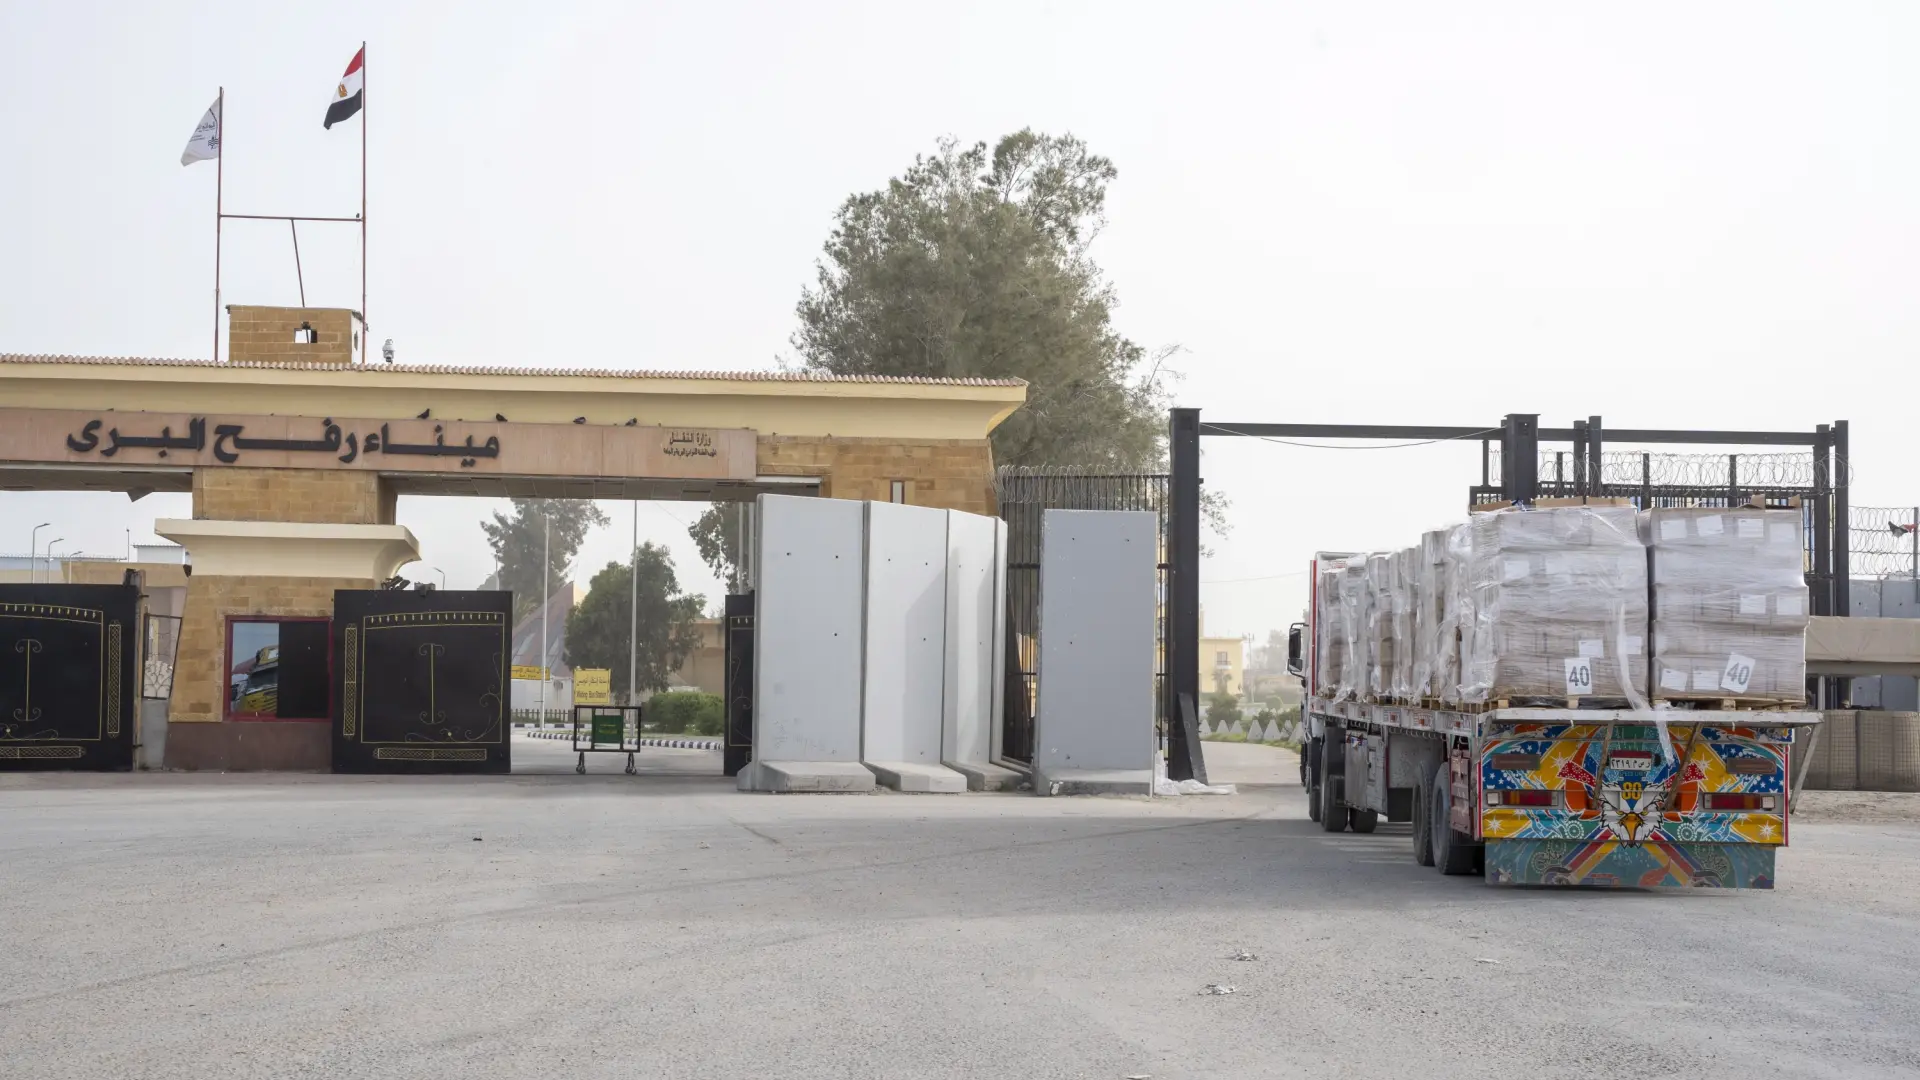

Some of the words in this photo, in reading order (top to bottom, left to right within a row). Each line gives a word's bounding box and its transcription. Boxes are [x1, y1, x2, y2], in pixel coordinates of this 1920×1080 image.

[213, 417, 358, 464] رفح
[362, 422, 500, 468] ميناء
[1568, 665, 1590, 687] 40
[1726, 662, 1750, 686] 40
[1622, 781, 1642, 800] 80
